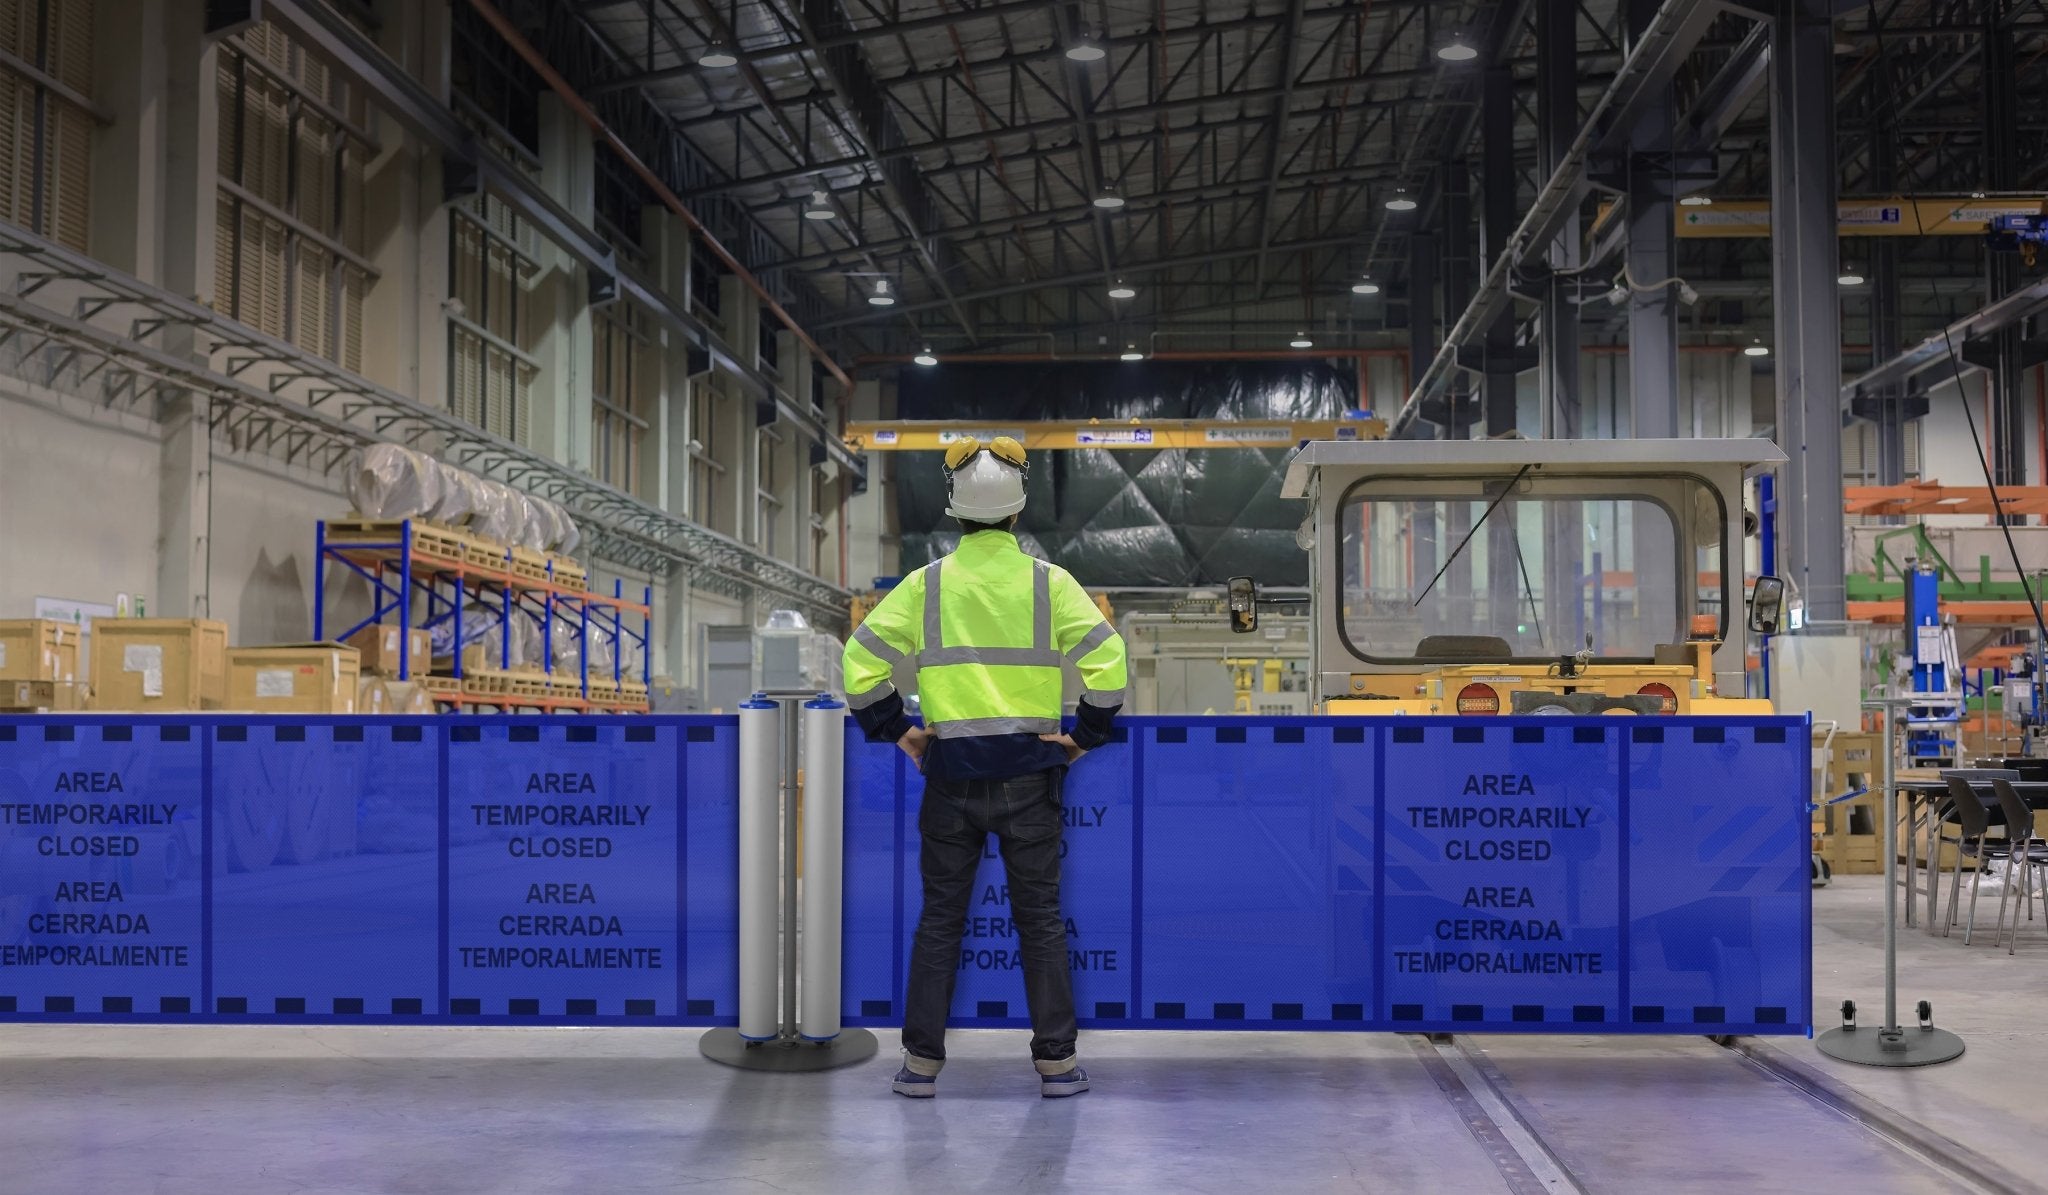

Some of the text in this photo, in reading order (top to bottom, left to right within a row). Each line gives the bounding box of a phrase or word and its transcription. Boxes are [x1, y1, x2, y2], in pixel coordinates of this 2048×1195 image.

[54, 772, 124, 792] AREA
[525, 773, 596, 793] AREA
[1463, 775, 1535, 795] AREA
[1, 804, 178, 825] TEMPORARILY
[471, 805, 651, 826] TEMPORARILY
[1407, 807, 1592, 828] TEMPORARILY
[37, 836, 140, 857] CLOSED
[508, 837, 612, 858] CLOSED
[1445, 840, 1552, 861] CLOSED
[54, 881, 124, 902] AREA
[526, 883, 596, 904] AREA
[1462, 887, 1535, 908] AREA
[28, 913, 151, 934] CERRADA
[499, 915, 623, 936] CERRADA
[1435, 919, 1563, 941] CERRADA
[0, 945, 188, 966] EMPORALMENTE
[459, 947, 662, 968] TEMPORALMENTE
[1394, 951, 1602, 974] TEMPORALMENTE
